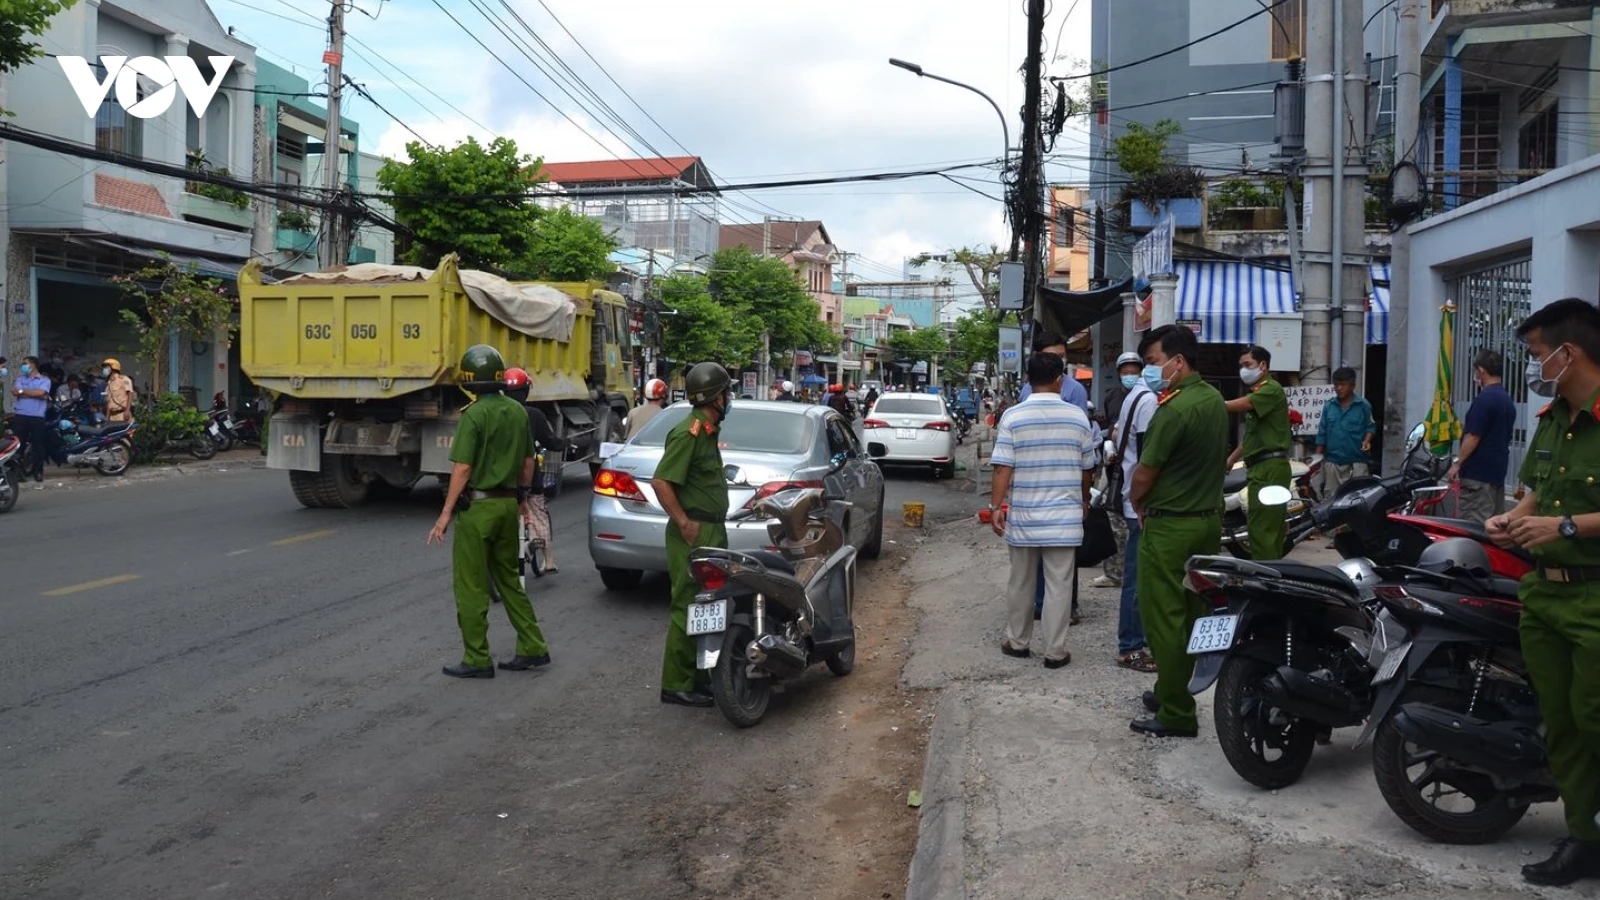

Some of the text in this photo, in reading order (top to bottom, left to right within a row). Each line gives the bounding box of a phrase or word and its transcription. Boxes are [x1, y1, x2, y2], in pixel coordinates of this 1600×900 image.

[305, 324, 420, 339] 63C 050 93
[283, 435, 305, 447] KIA
